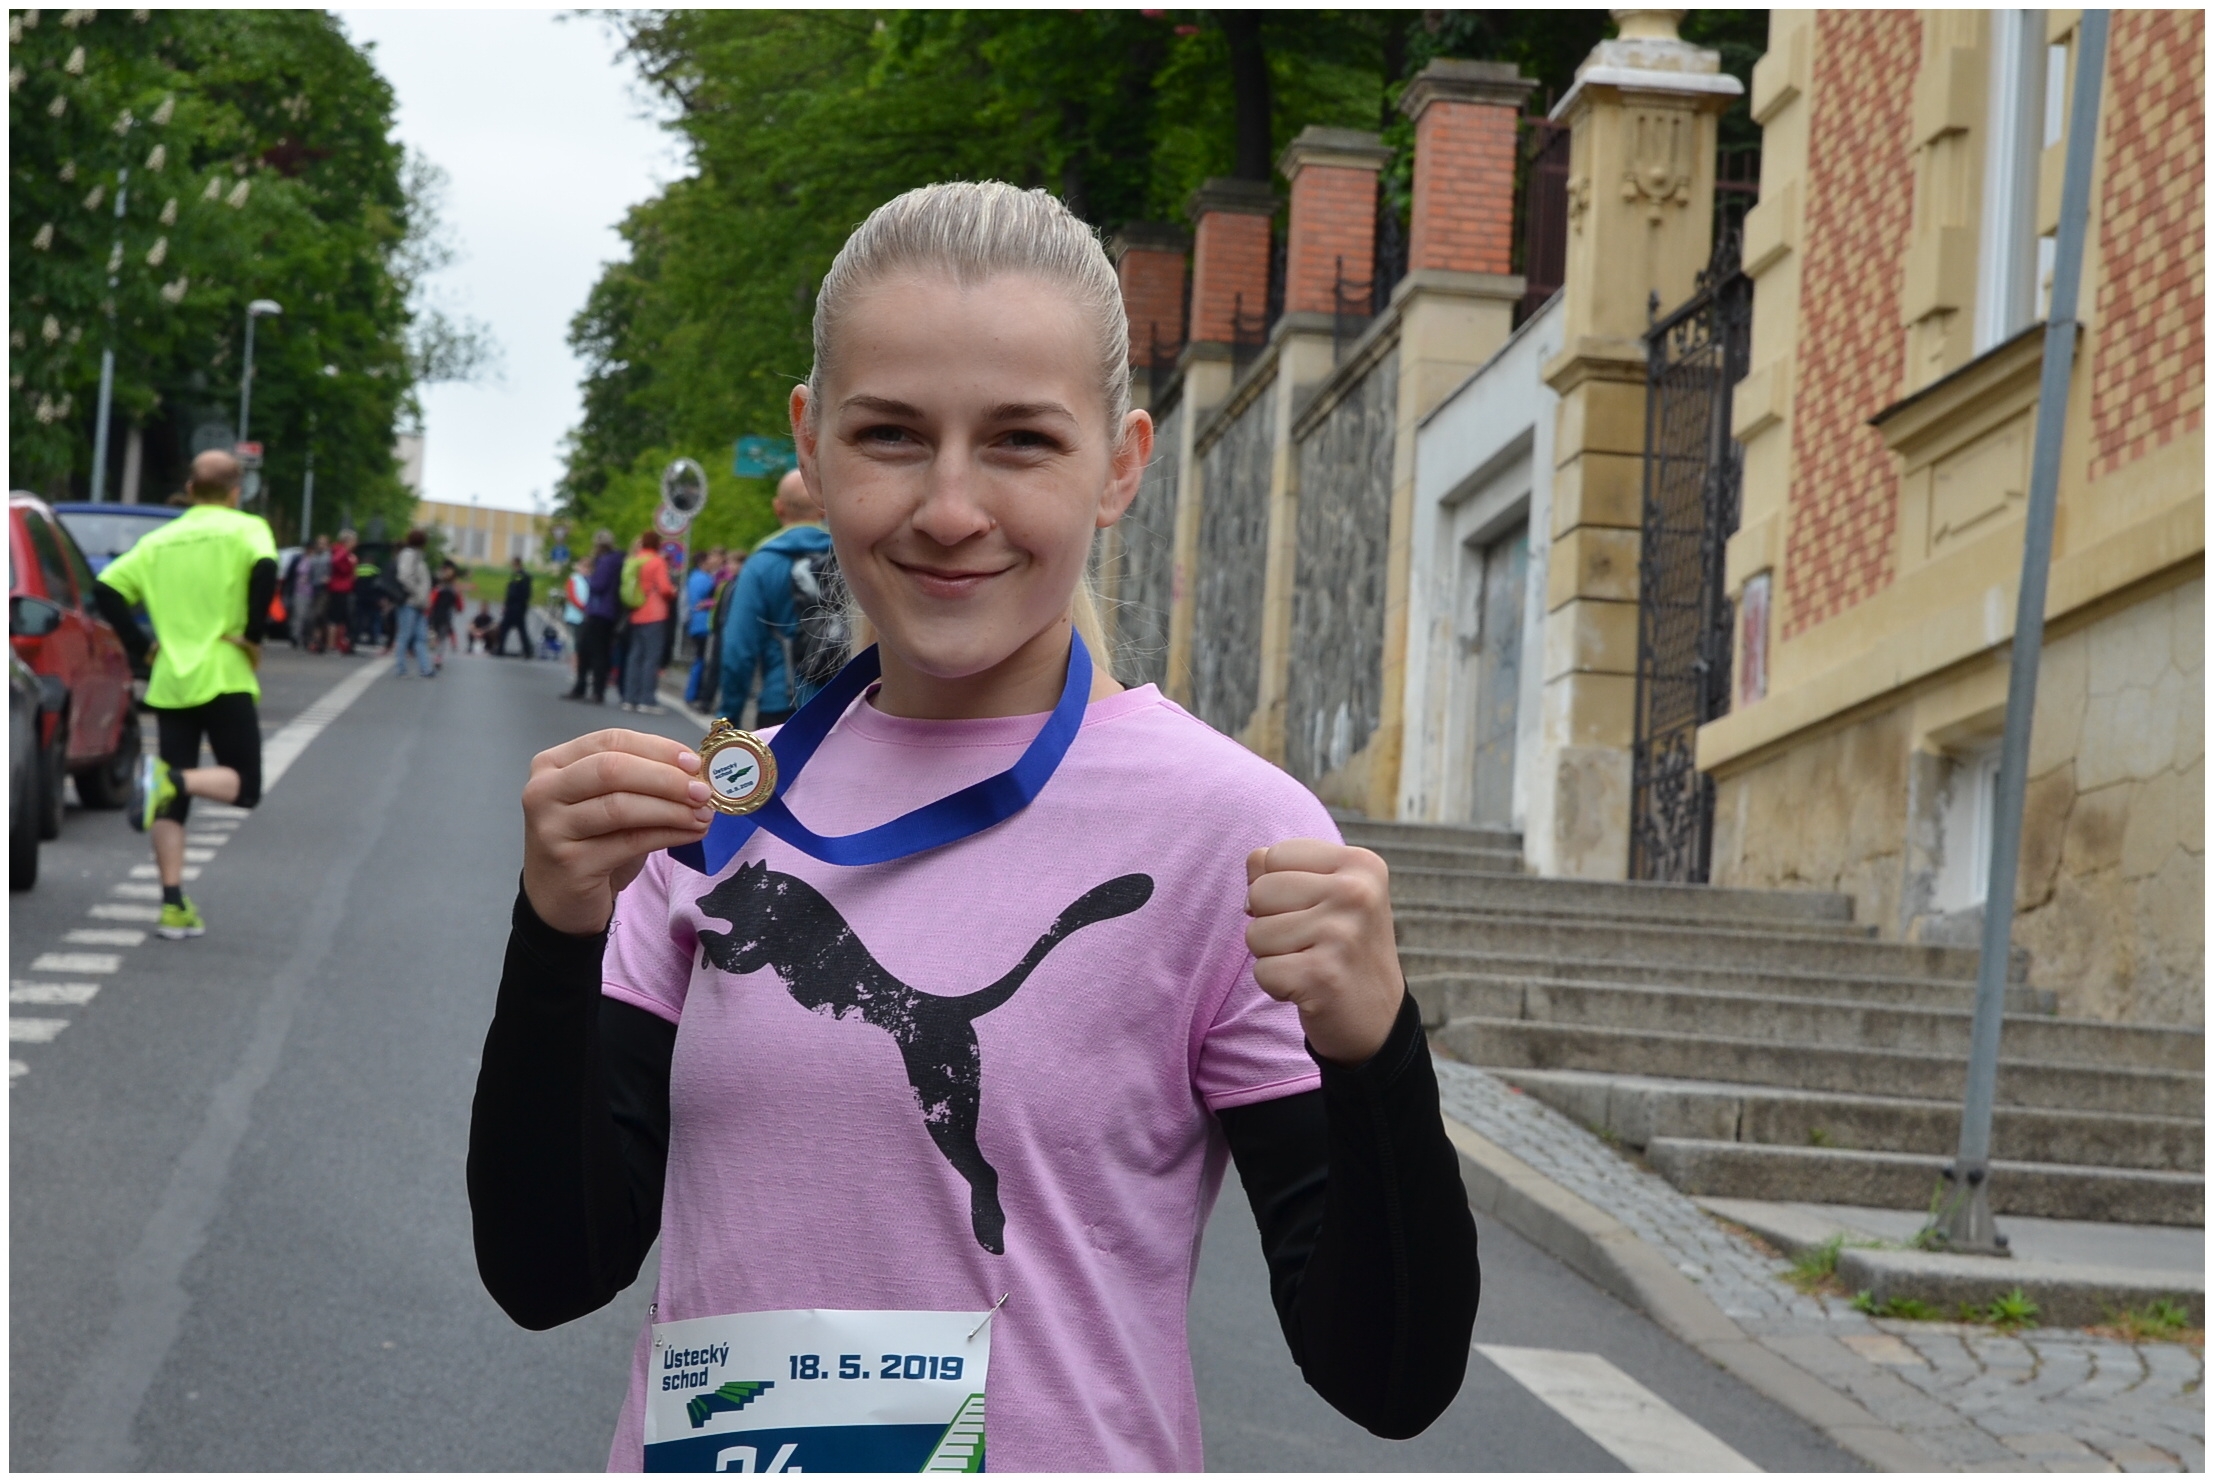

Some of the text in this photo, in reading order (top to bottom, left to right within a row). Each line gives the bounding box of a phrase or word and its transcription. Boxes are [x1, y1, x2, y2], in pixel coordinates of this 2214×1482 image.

[664, 1341, 729, 1369] Ústecký
[789, 1354, 964, 1380] 18. 5. 2019
[662, 1366, 709, 1391] schod
